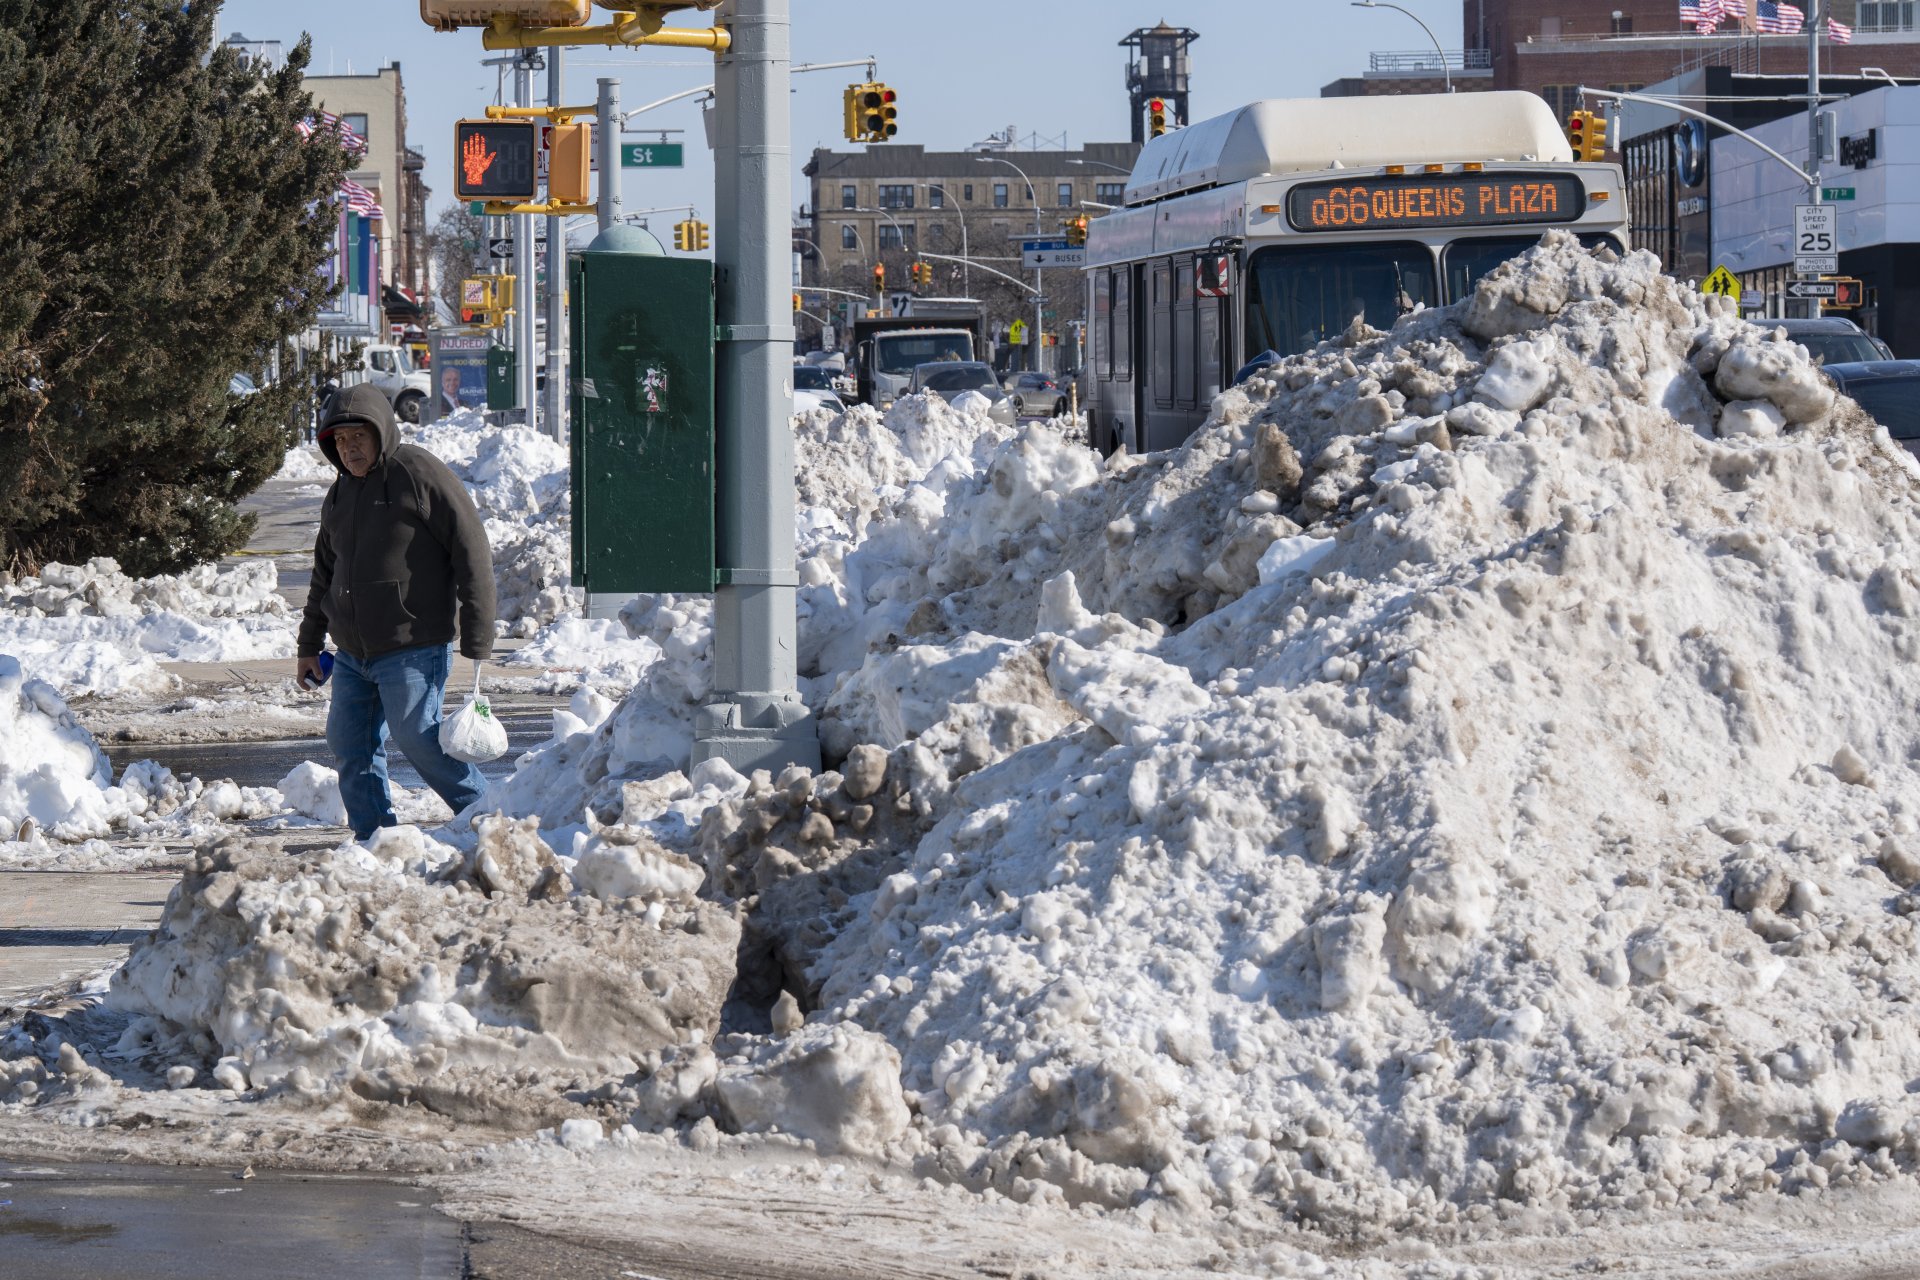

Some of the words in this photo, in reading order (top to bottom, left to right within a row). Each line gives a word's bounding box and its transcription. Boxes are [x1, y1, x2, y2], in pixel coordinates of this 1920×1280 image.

[632, 147, 654, 163] St
[1829, 189, 1839, 199] 77
[1372, 187, 1465, 219] QUEENS
[1479, 183, 1558, 214] PLAZA
[534, 243, 545, 251] AY
[1801, 233, 1831, 251] 25
[1055, 254, 1082, 262] BUSES
